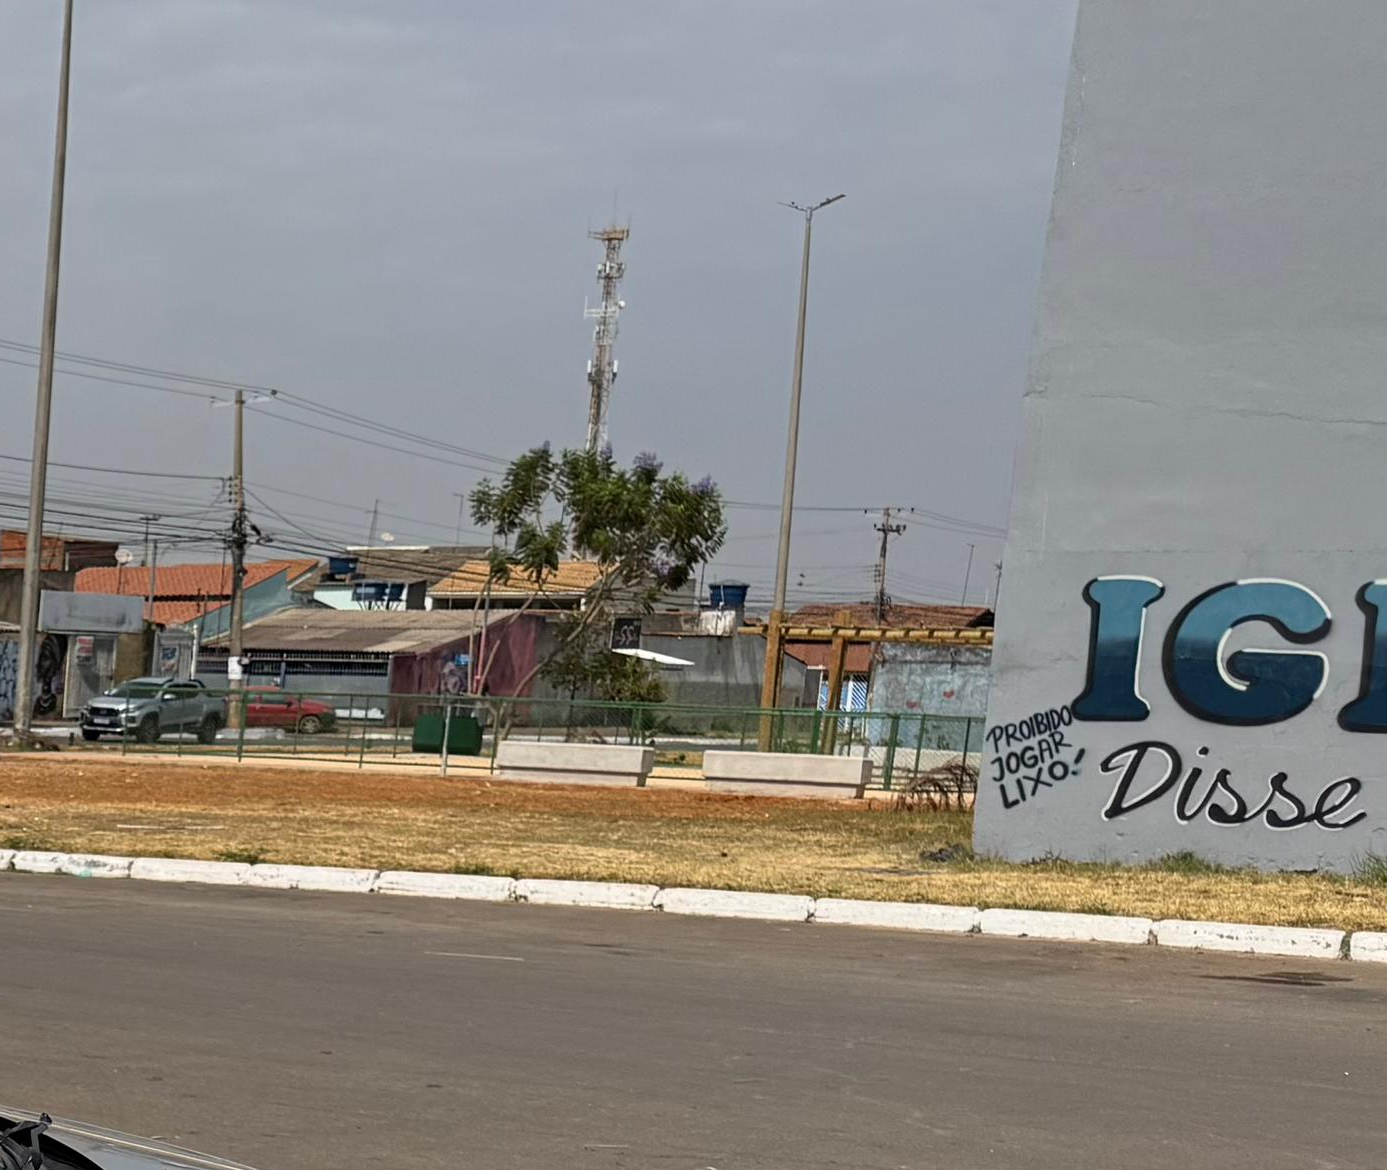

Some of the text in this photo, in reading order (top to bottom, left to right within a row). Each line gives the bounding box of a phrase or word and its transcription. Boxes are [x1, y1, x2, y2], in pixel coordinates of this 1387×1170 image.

[1070, 574, 1387, 733] IG
[985, 705, 1073, 754] PROIBIDO
[990, 730, 1073, 782] JOGAR
[999, 747, 1086, 809] LIXO!
[1099, 740, 1367, 830] Disse
